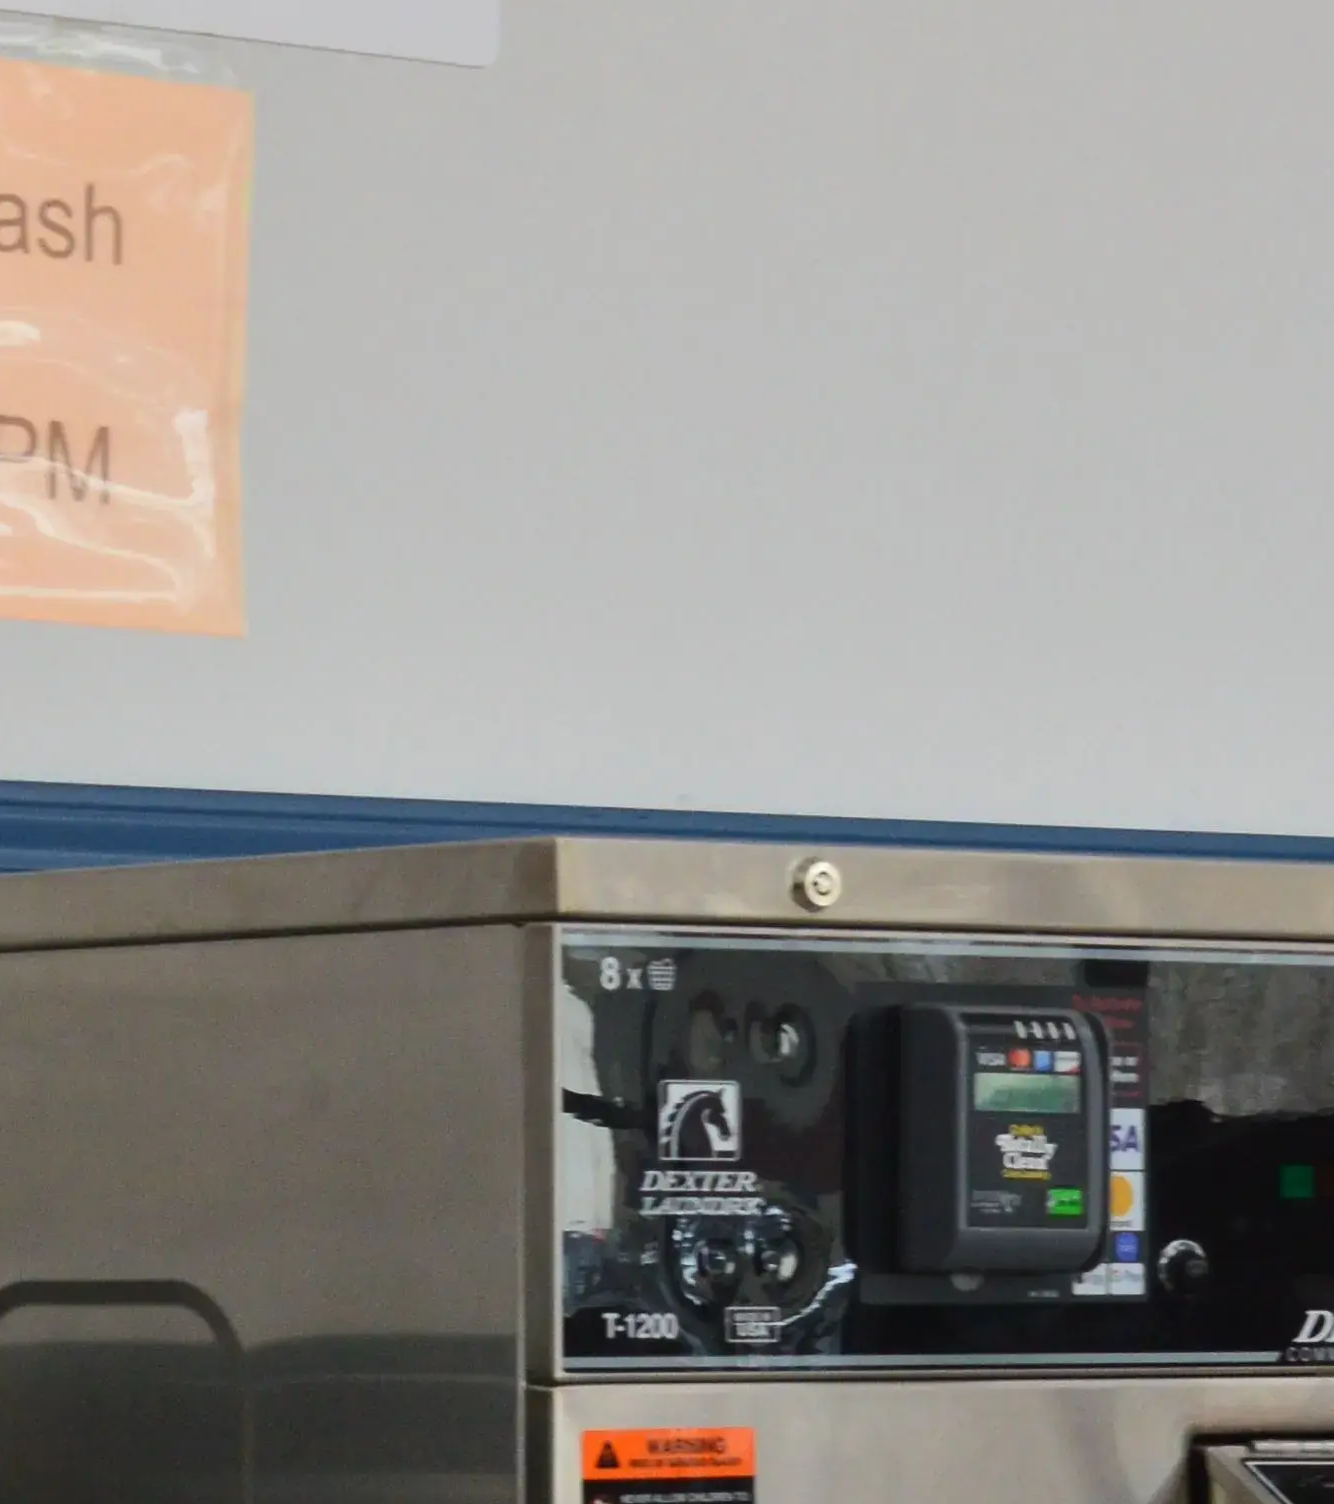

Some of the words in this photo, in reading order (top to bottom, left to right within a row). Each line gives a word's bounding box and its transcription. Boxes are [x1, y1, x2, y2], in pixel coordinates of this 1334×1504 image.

[600, 956, 621, 991] 8
[639, 1171, 758, 1192] DEXTER
[601, 1312, 680, 1339] T-1200
